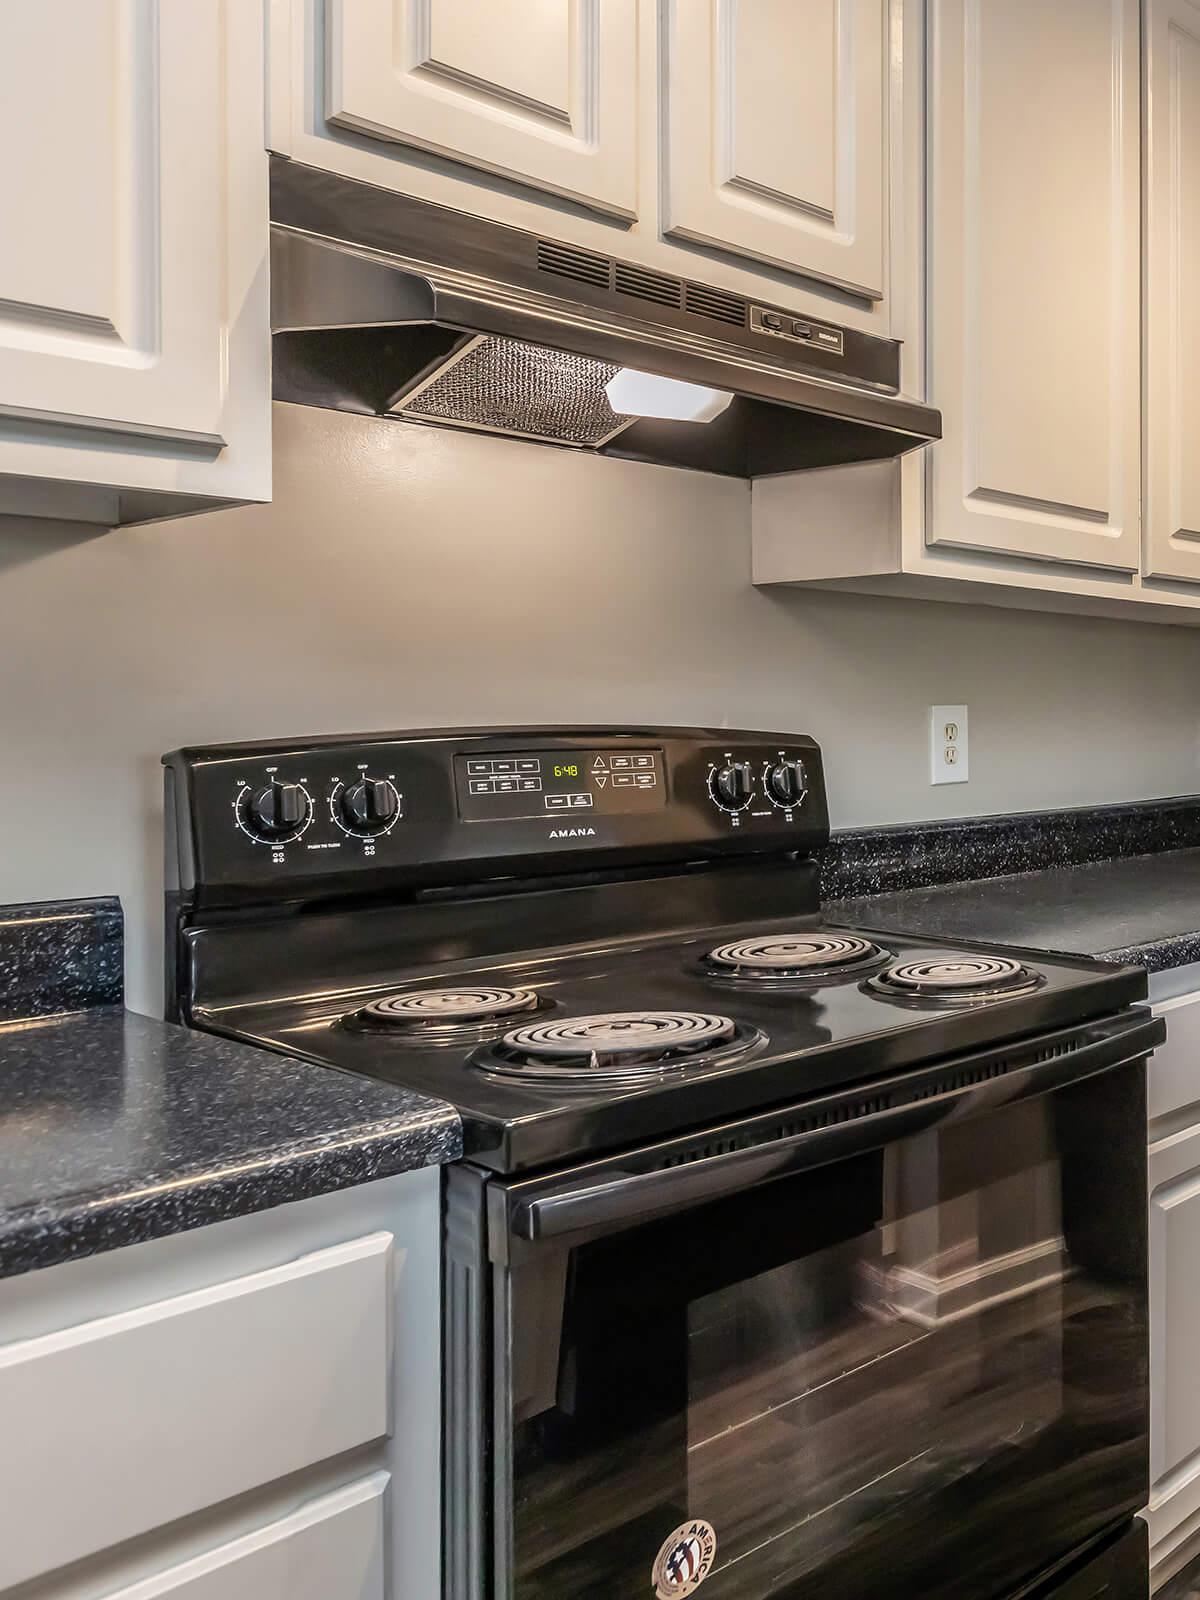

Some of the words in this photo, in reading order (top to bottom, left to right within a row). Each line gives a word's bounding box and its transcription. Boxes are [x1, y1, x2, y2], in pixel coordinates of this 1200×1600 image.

[554, 765, 578, 777] 6:48
[549, 827, 596, 839] AMANA
[688, 1523, 713, 1584] AMERICA
